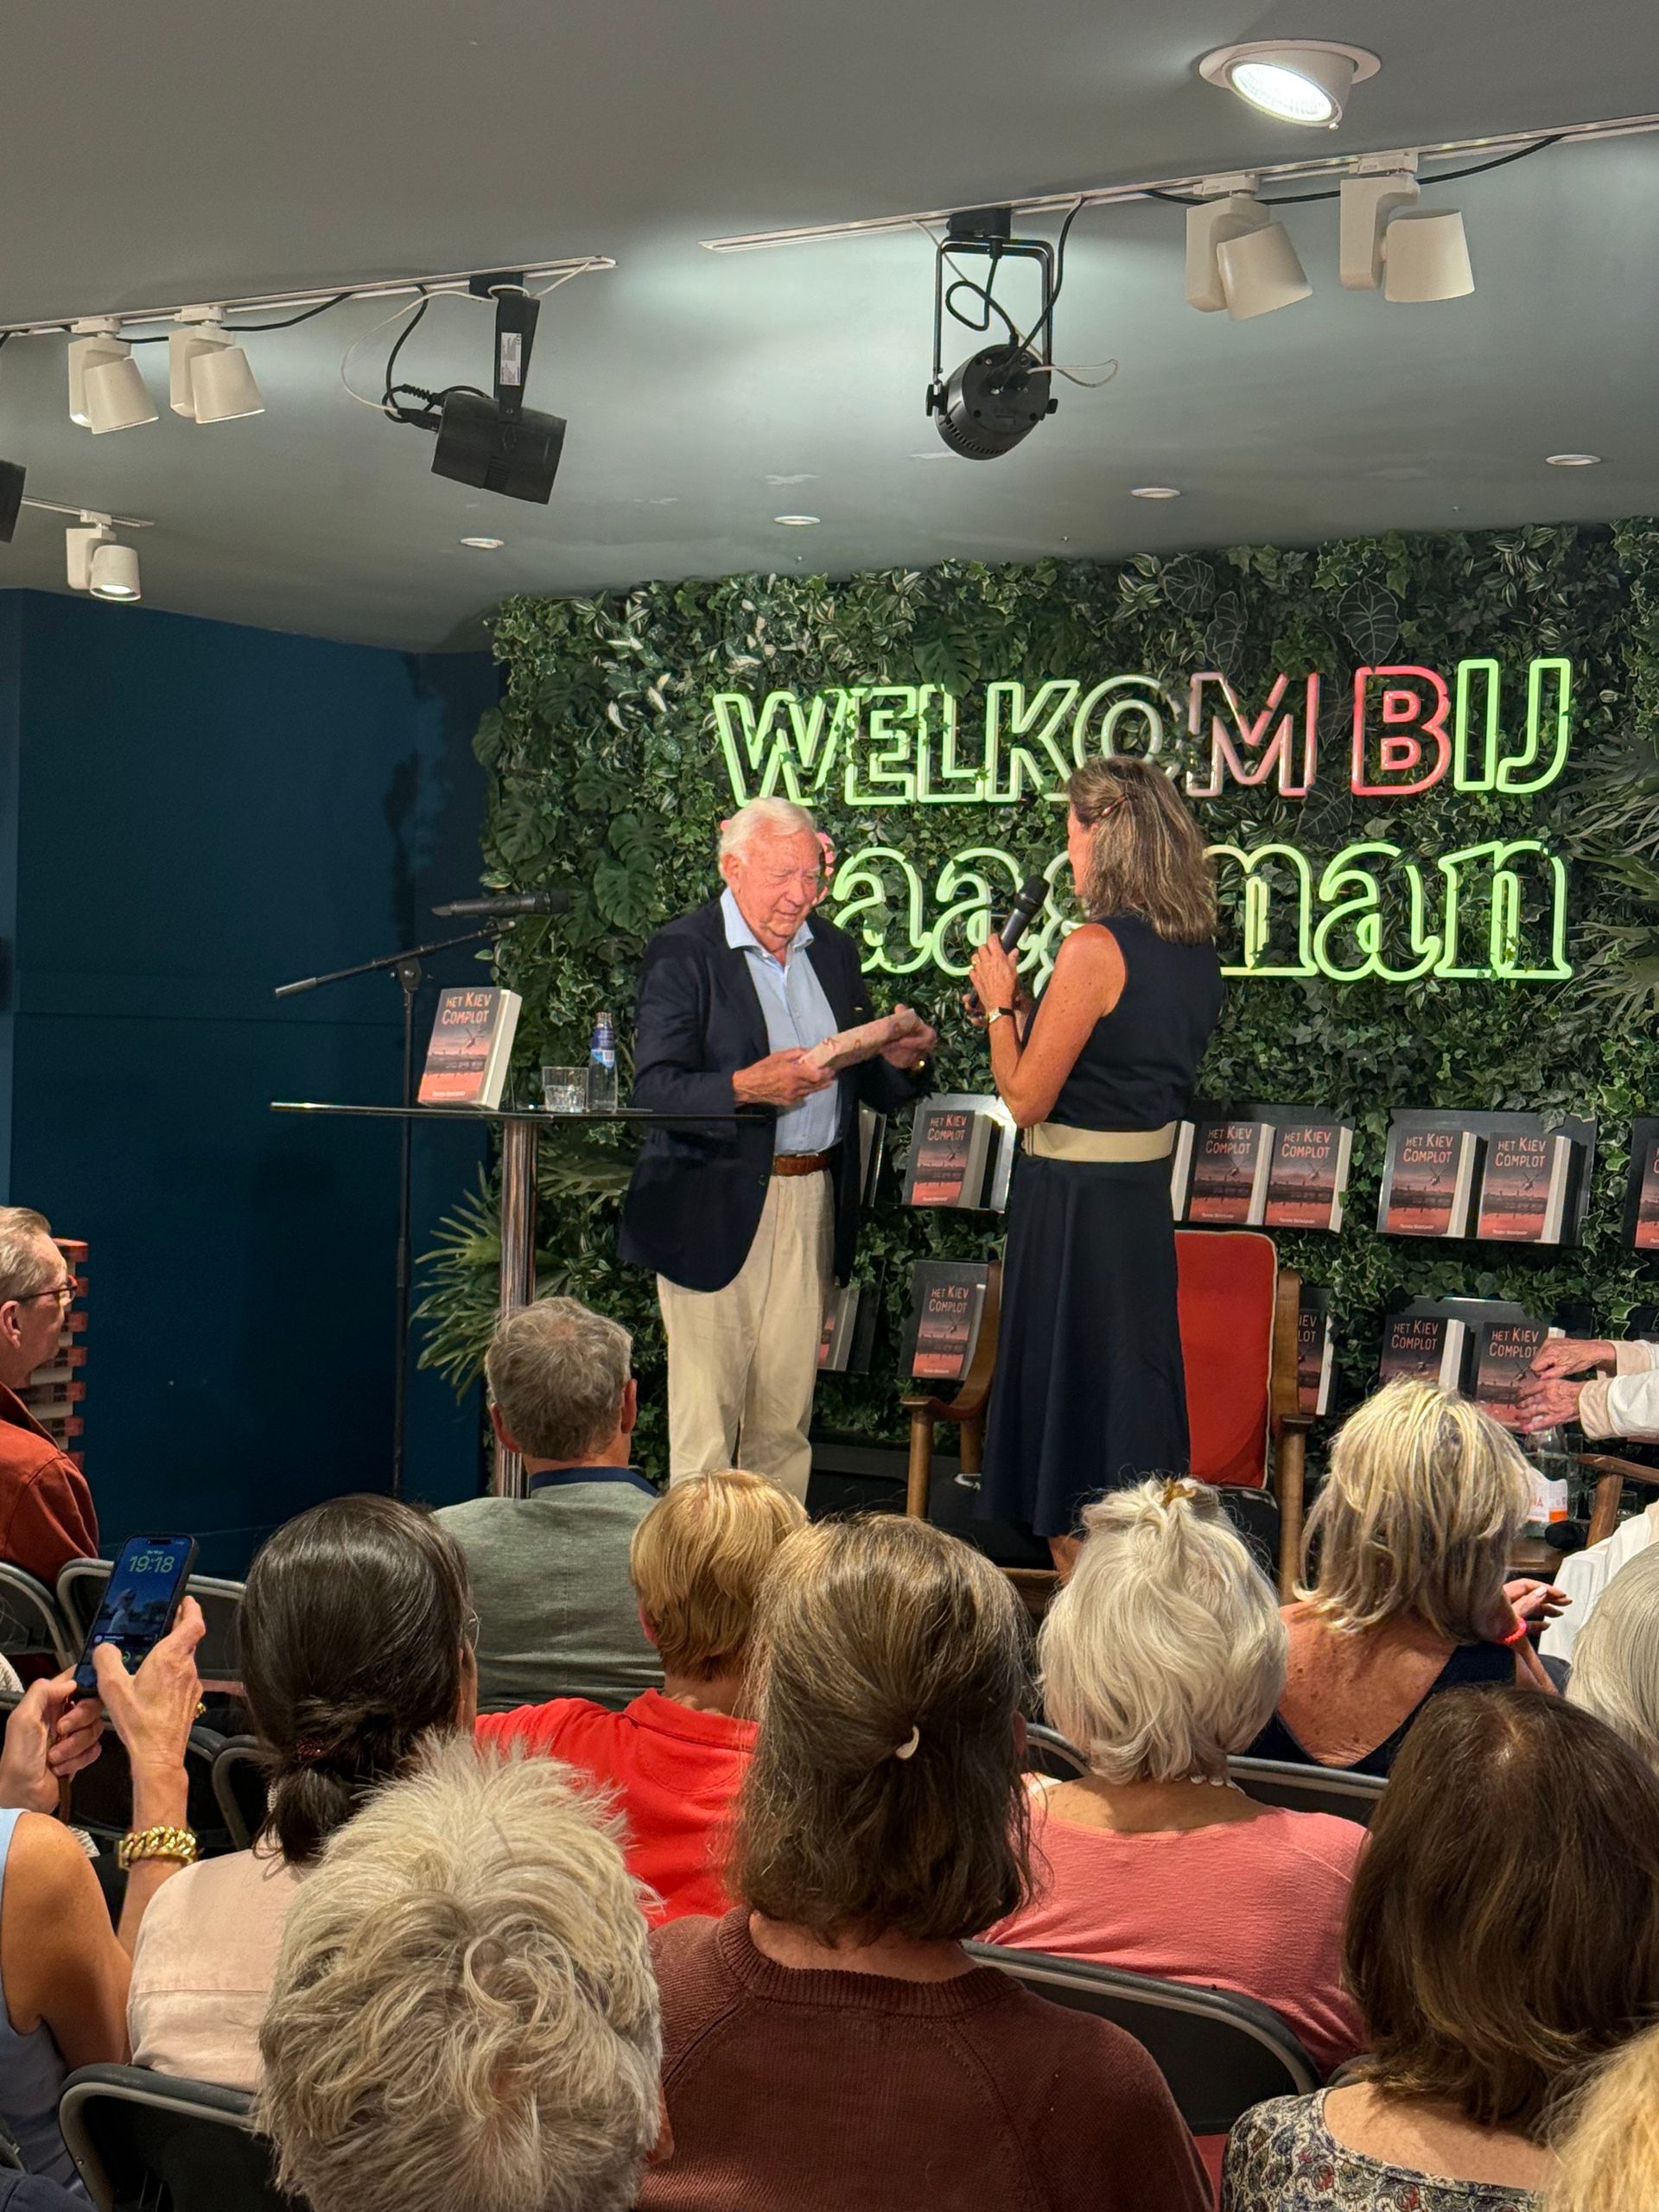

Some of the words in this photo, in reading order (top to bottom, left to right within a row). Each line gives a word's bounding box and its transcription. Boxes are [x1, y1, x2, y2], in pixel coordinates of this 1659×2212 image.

[712, 673, 1320, 807] WELKOM
[1351, 658, 1571, 796] BIJ
[719, 819, 1574, 998] aaman
[446, 996, 463, 1008] HET
[465, 991, 492, 1007] KIEV
[442, 1009, 489, 1025] COMPLOT
[1209, 1128, 1224, 1139] HET
[1227, 1125, 1253, 1140] KIEV
[1284, 1133, 1300, 1142] HET
[1304, 1128, 1332, 1144] KIEV
[1406, 1136, 1423, 1147] HET
[1426, 1134, 1453, 1147] KIEV
[1205, 1141, 1251, 1154] COMPLOT
[1281, 1144, 1331, 1159] COMPLOT
[1498, 1141, 1516, 1151] HET
[1519, 1137, 1547, 1152] KIEV
[1402, 1148, 1452, 1163] COMPLOT
[1495, 1153, 1545, 1167] COMPLOT
[1299, 1314, 1318, 1328] IEV
[1394, 1324, 1410, 1334] HET
[1414, 1319, 1439, 1335] KIEV
[1391, 1335, 1438, 1351] COMPLOT
[1491, 1330, 1509, 1341] HET
[1512, 1327, 1539, 1343] KIEV
[1489, 1342, 1538, 1358] COMPLOT
[130, 1555, 175, 1573] 19:18
